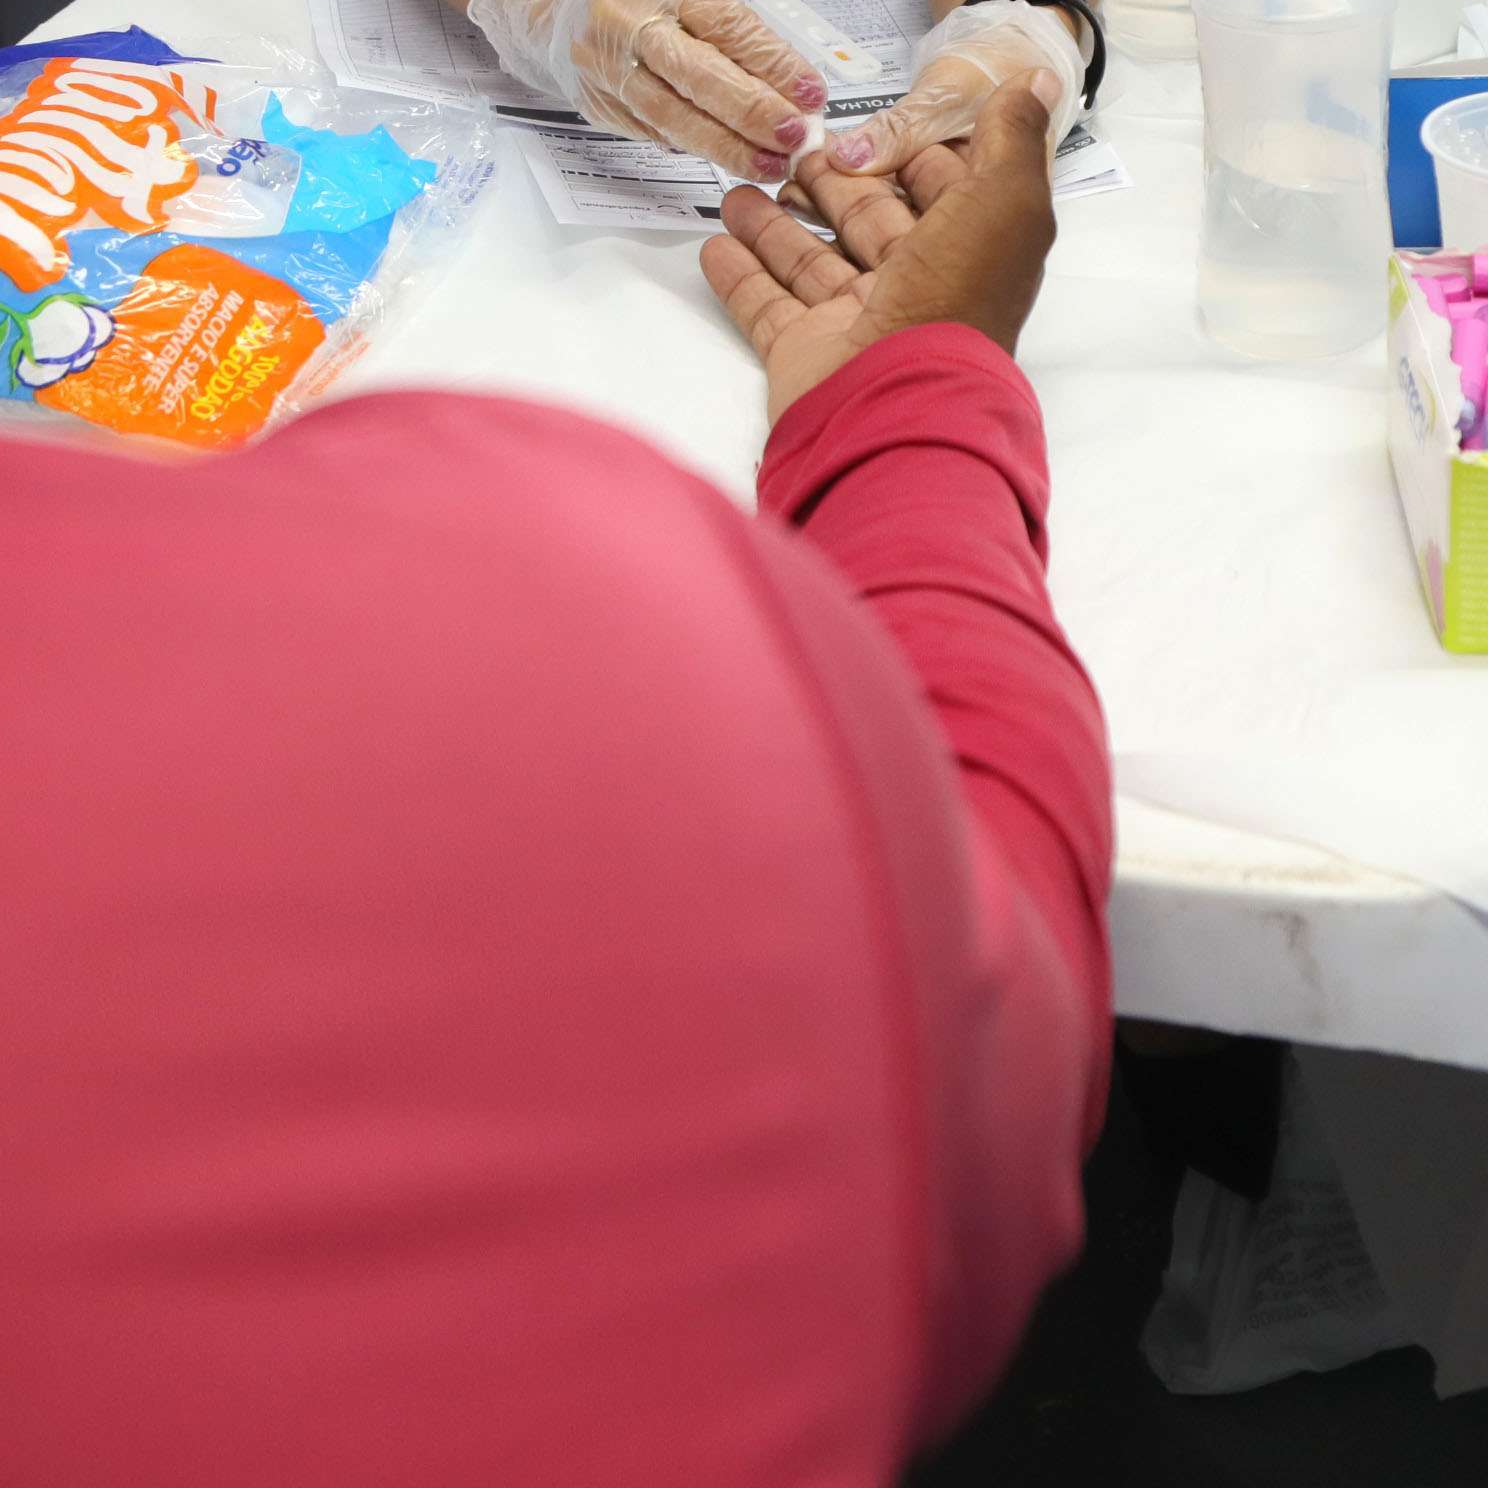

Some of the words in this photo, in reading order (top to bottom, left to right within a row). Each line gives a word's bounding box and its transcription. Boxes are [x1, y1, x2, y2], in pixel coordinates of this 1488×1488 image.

[834, 96, 902, 113] FOLHA
[142, 283, 219, 392] ABSORVENTE
[198, 290, 244, 355] MACIO
